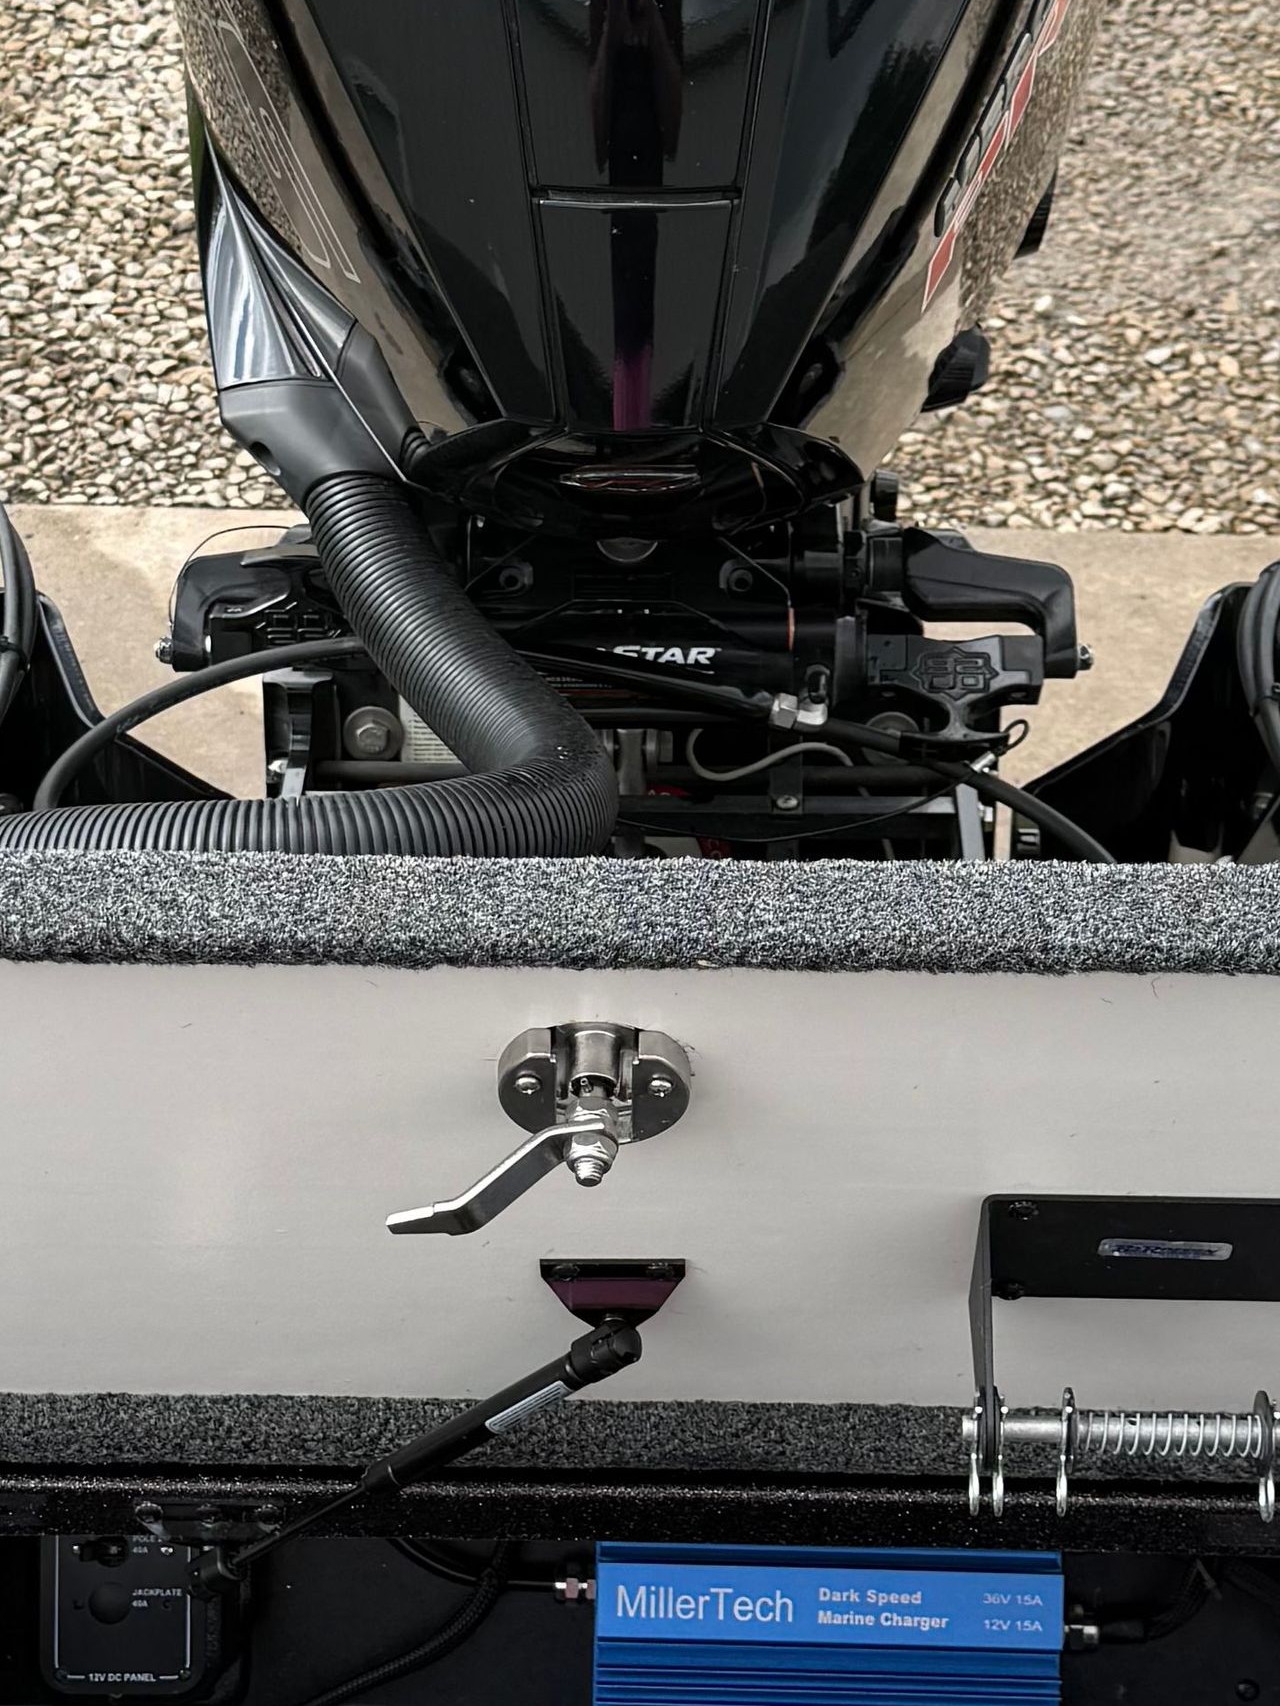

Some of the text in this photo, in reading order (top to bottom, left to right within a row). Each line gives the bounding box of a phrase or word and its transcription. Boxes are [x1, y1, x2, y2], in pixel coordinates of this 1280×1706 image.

[131, 1588, 183, 1597] JACKPLATE
[819, 1587, 923, 1605] Dark Speed
[617, 1585, 793, 1622] MillerTech
[983, 1593, 1043, 1606] 36V 15A
[818, 1610, 950, 1632] Marine Charger
[984, 1619, 1043, 1632] 12V 15A
[88, 1673, 157, 1683] 12V DC PANEL
